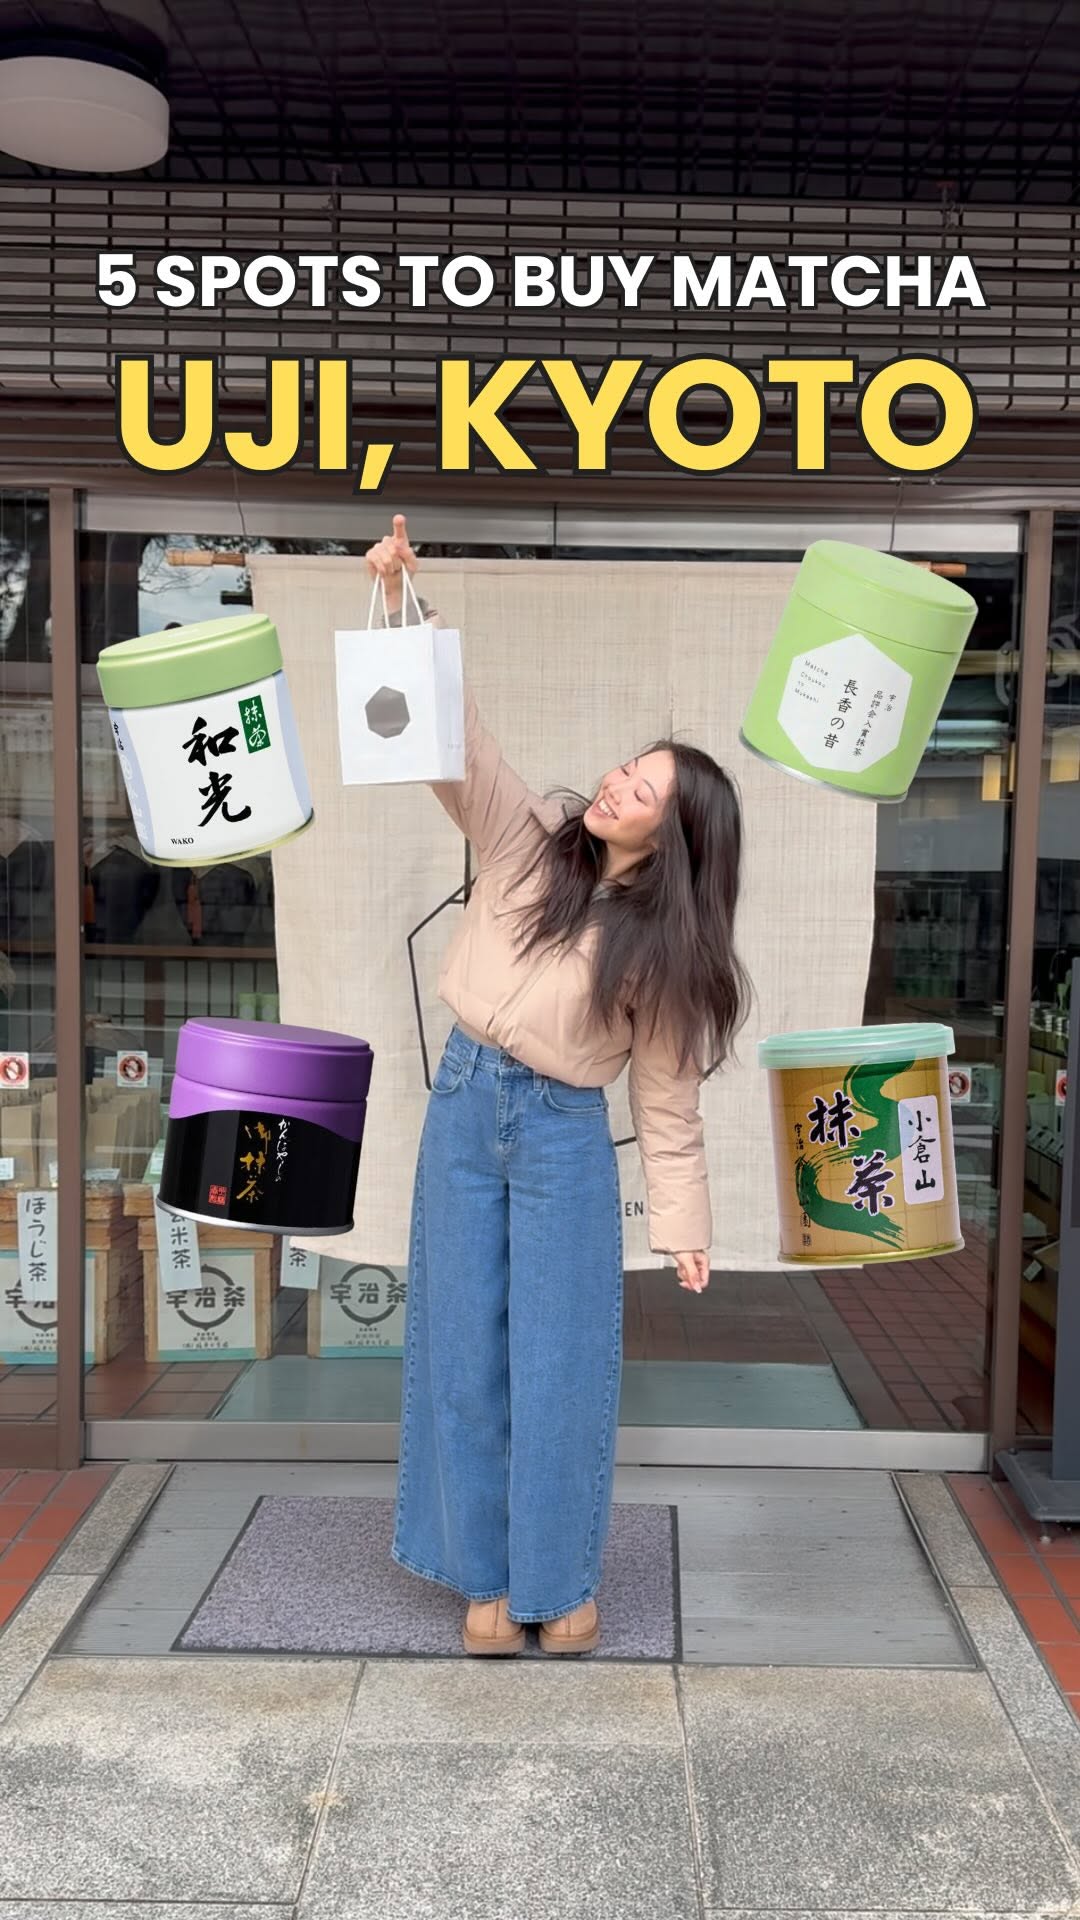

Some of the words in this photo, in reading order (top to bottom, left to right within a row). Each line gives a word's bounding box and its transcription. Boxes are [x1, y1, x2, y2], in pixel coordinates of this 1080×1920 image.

[243, 699, 267, 748] 抹茶
[823, 678, 859, 750] 長香の昔
[181, 716, 252, 828] 和光
[170, 837, 195, 846] WAKO
[807, 1091, 895, 1216] 抹茶
[908, 1109, 937, 1192] 小倉山
[624, 1200, 644, 1217] EN
[26, 1196, 48, 1283] ほうじ茶
[166, 1286, 246, 1309] 宇治茶
[330, 1282, 409, 1305] 宇治茶
